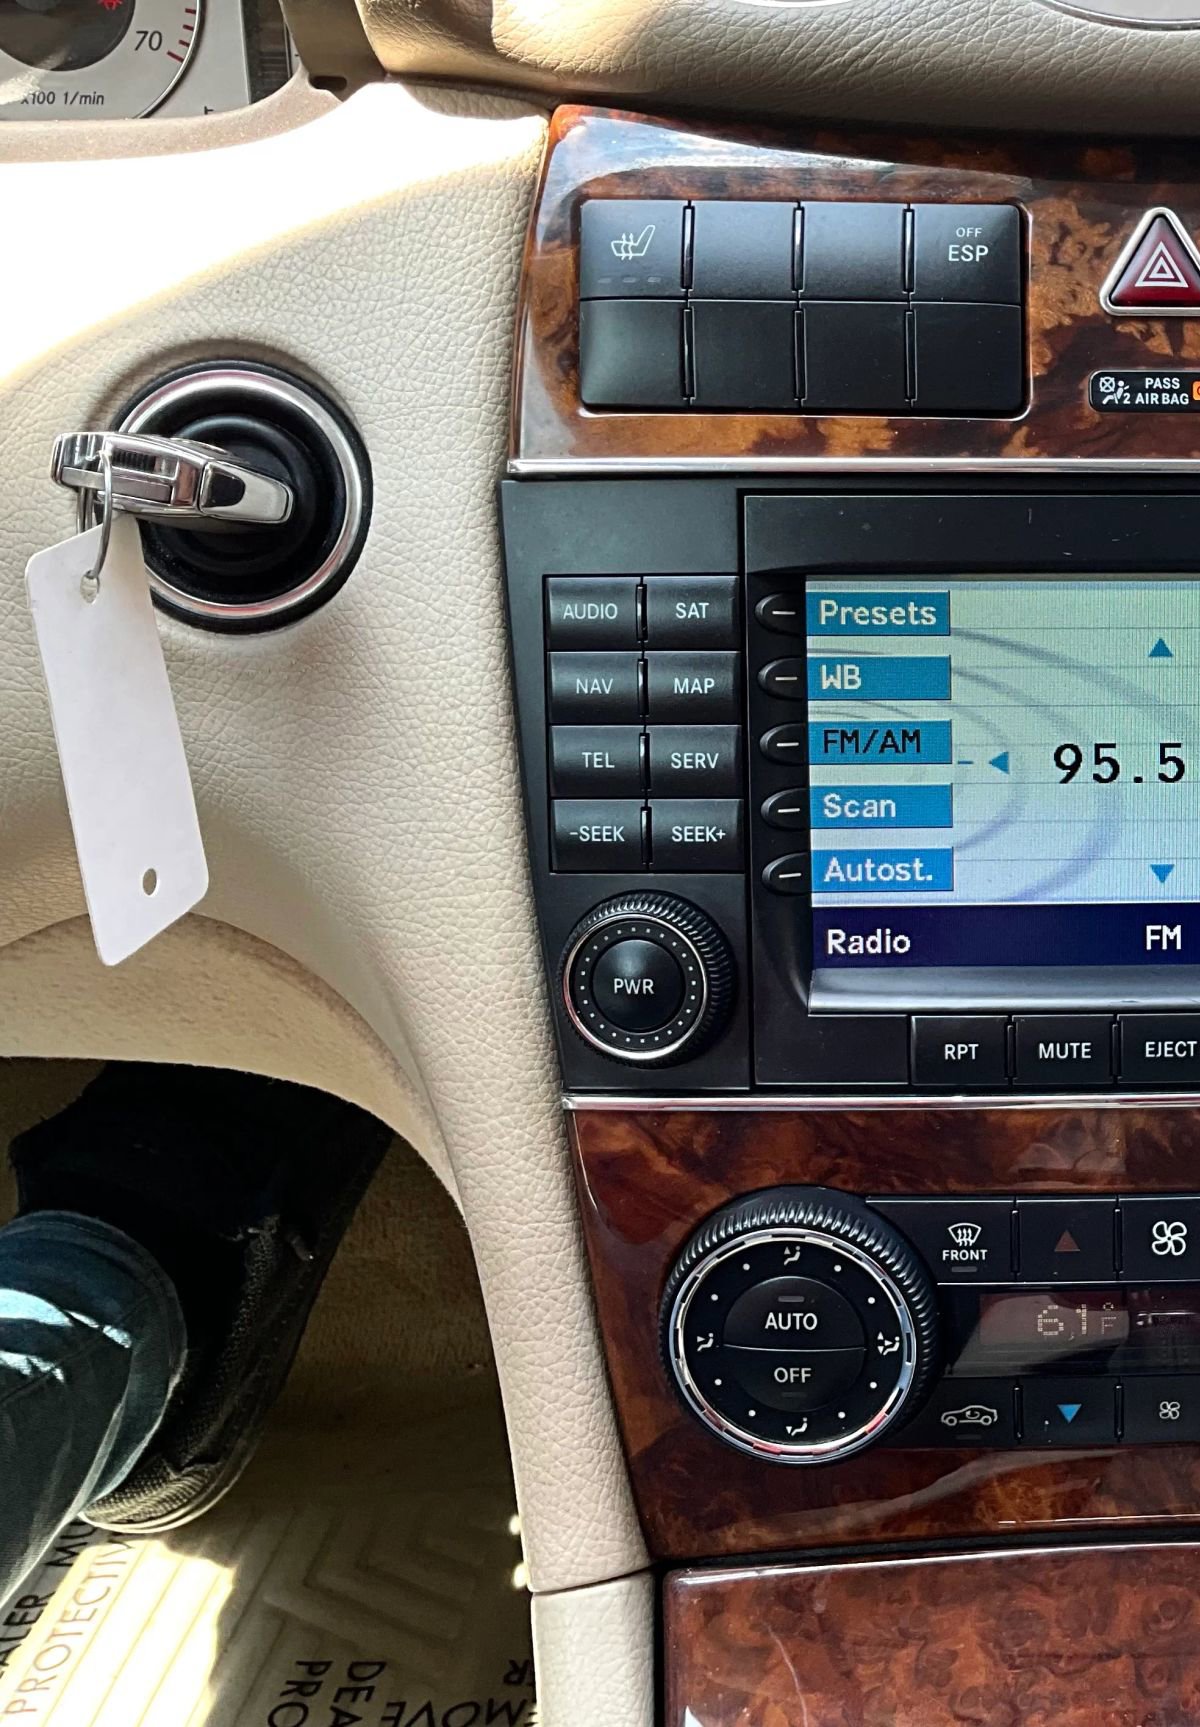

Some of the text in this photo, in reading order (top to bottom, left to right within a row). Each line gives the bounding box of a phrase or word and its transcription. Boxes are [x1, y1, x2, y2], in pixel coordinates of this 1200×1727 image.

[133, 30, 162, 51] 70
[64, 91, 104, 105] 1/min
[955, 226, 983, 238] OFF
[948, 244, 989, 262] ESP
[1144, 377, 1181, 390] PASS
[562, 602, 618, 620] AUDIO
[675, 602, 710, 619] SAT
[820, 599, 937, 626] Presets
[673, 677, 715, 694] MAP
[821, 663, 867, 690] WB
[576, 678, 614, 695] NAV
[823, 728, 921, 755] FM/AM
[581, 751, 615, 769] TEL
[670, 751, 719, 769] SERV
[1053, 742, 1186, 785] 95.5
[823, 792, 896, 819] Scan
[671, 825, 726, 843] SEEK+
[823, 856, 933, 887] Autost.
[827, 928, 911, 955] Radio
[1146, 924, 1182, 951] FM
[613, 974, 654, 995] PWR
[944, 1043, 979, 1060] RPT
[1038, 1042, 1092, 1059] MUTE
[1145, 1040, 1198, 1058] EJECT
[942, 1249, 988, 1261] FRONT
[764, 1311, 818, 1331] AUTO
[773, 1366, 812, 1384] OFF
